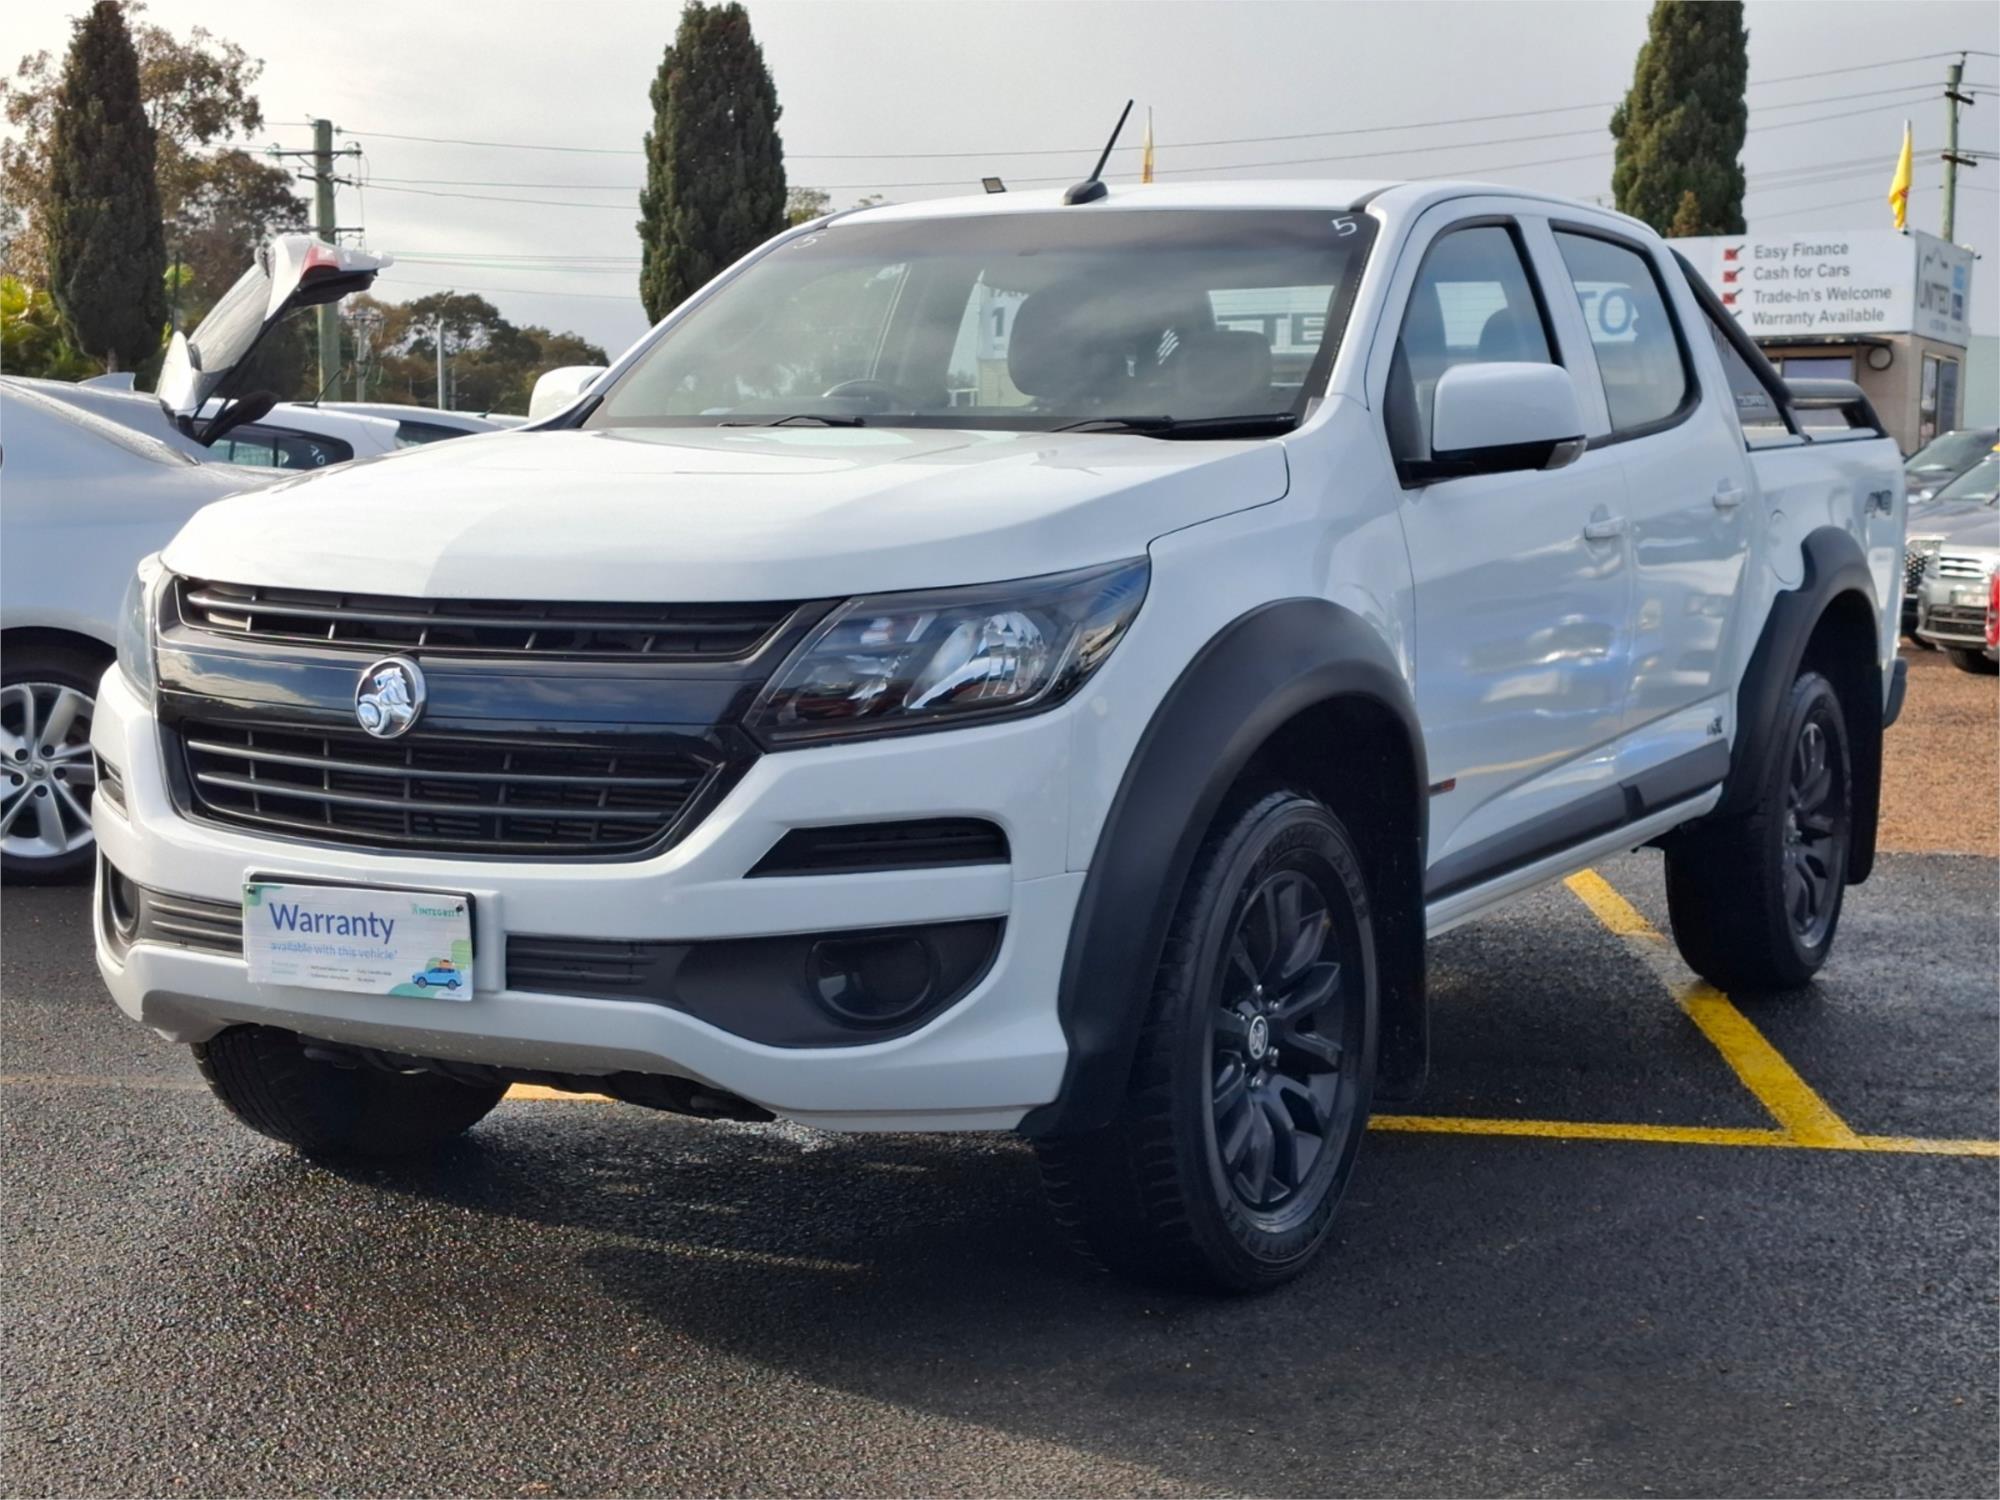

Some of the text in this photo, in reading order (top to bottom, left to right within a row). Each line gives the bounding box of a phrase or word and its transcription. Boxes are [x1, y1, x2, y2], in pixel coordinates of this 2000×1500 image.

[1331, 215, 1358, 237] 5
[1754, 242, 1848, 261] Easy Finance
[1753, 264, 1850, 281] Cash for Cars
[1753, 286, 1892, 304] Trade-In's Welcome
[1752, 307, 1884, 327] Warranty Available
[268, 902, 395, 945] Warranty
[271, 941, 313, 954] available
[314, 944, 336, 957] with
[338, 945, 358, 957] this
